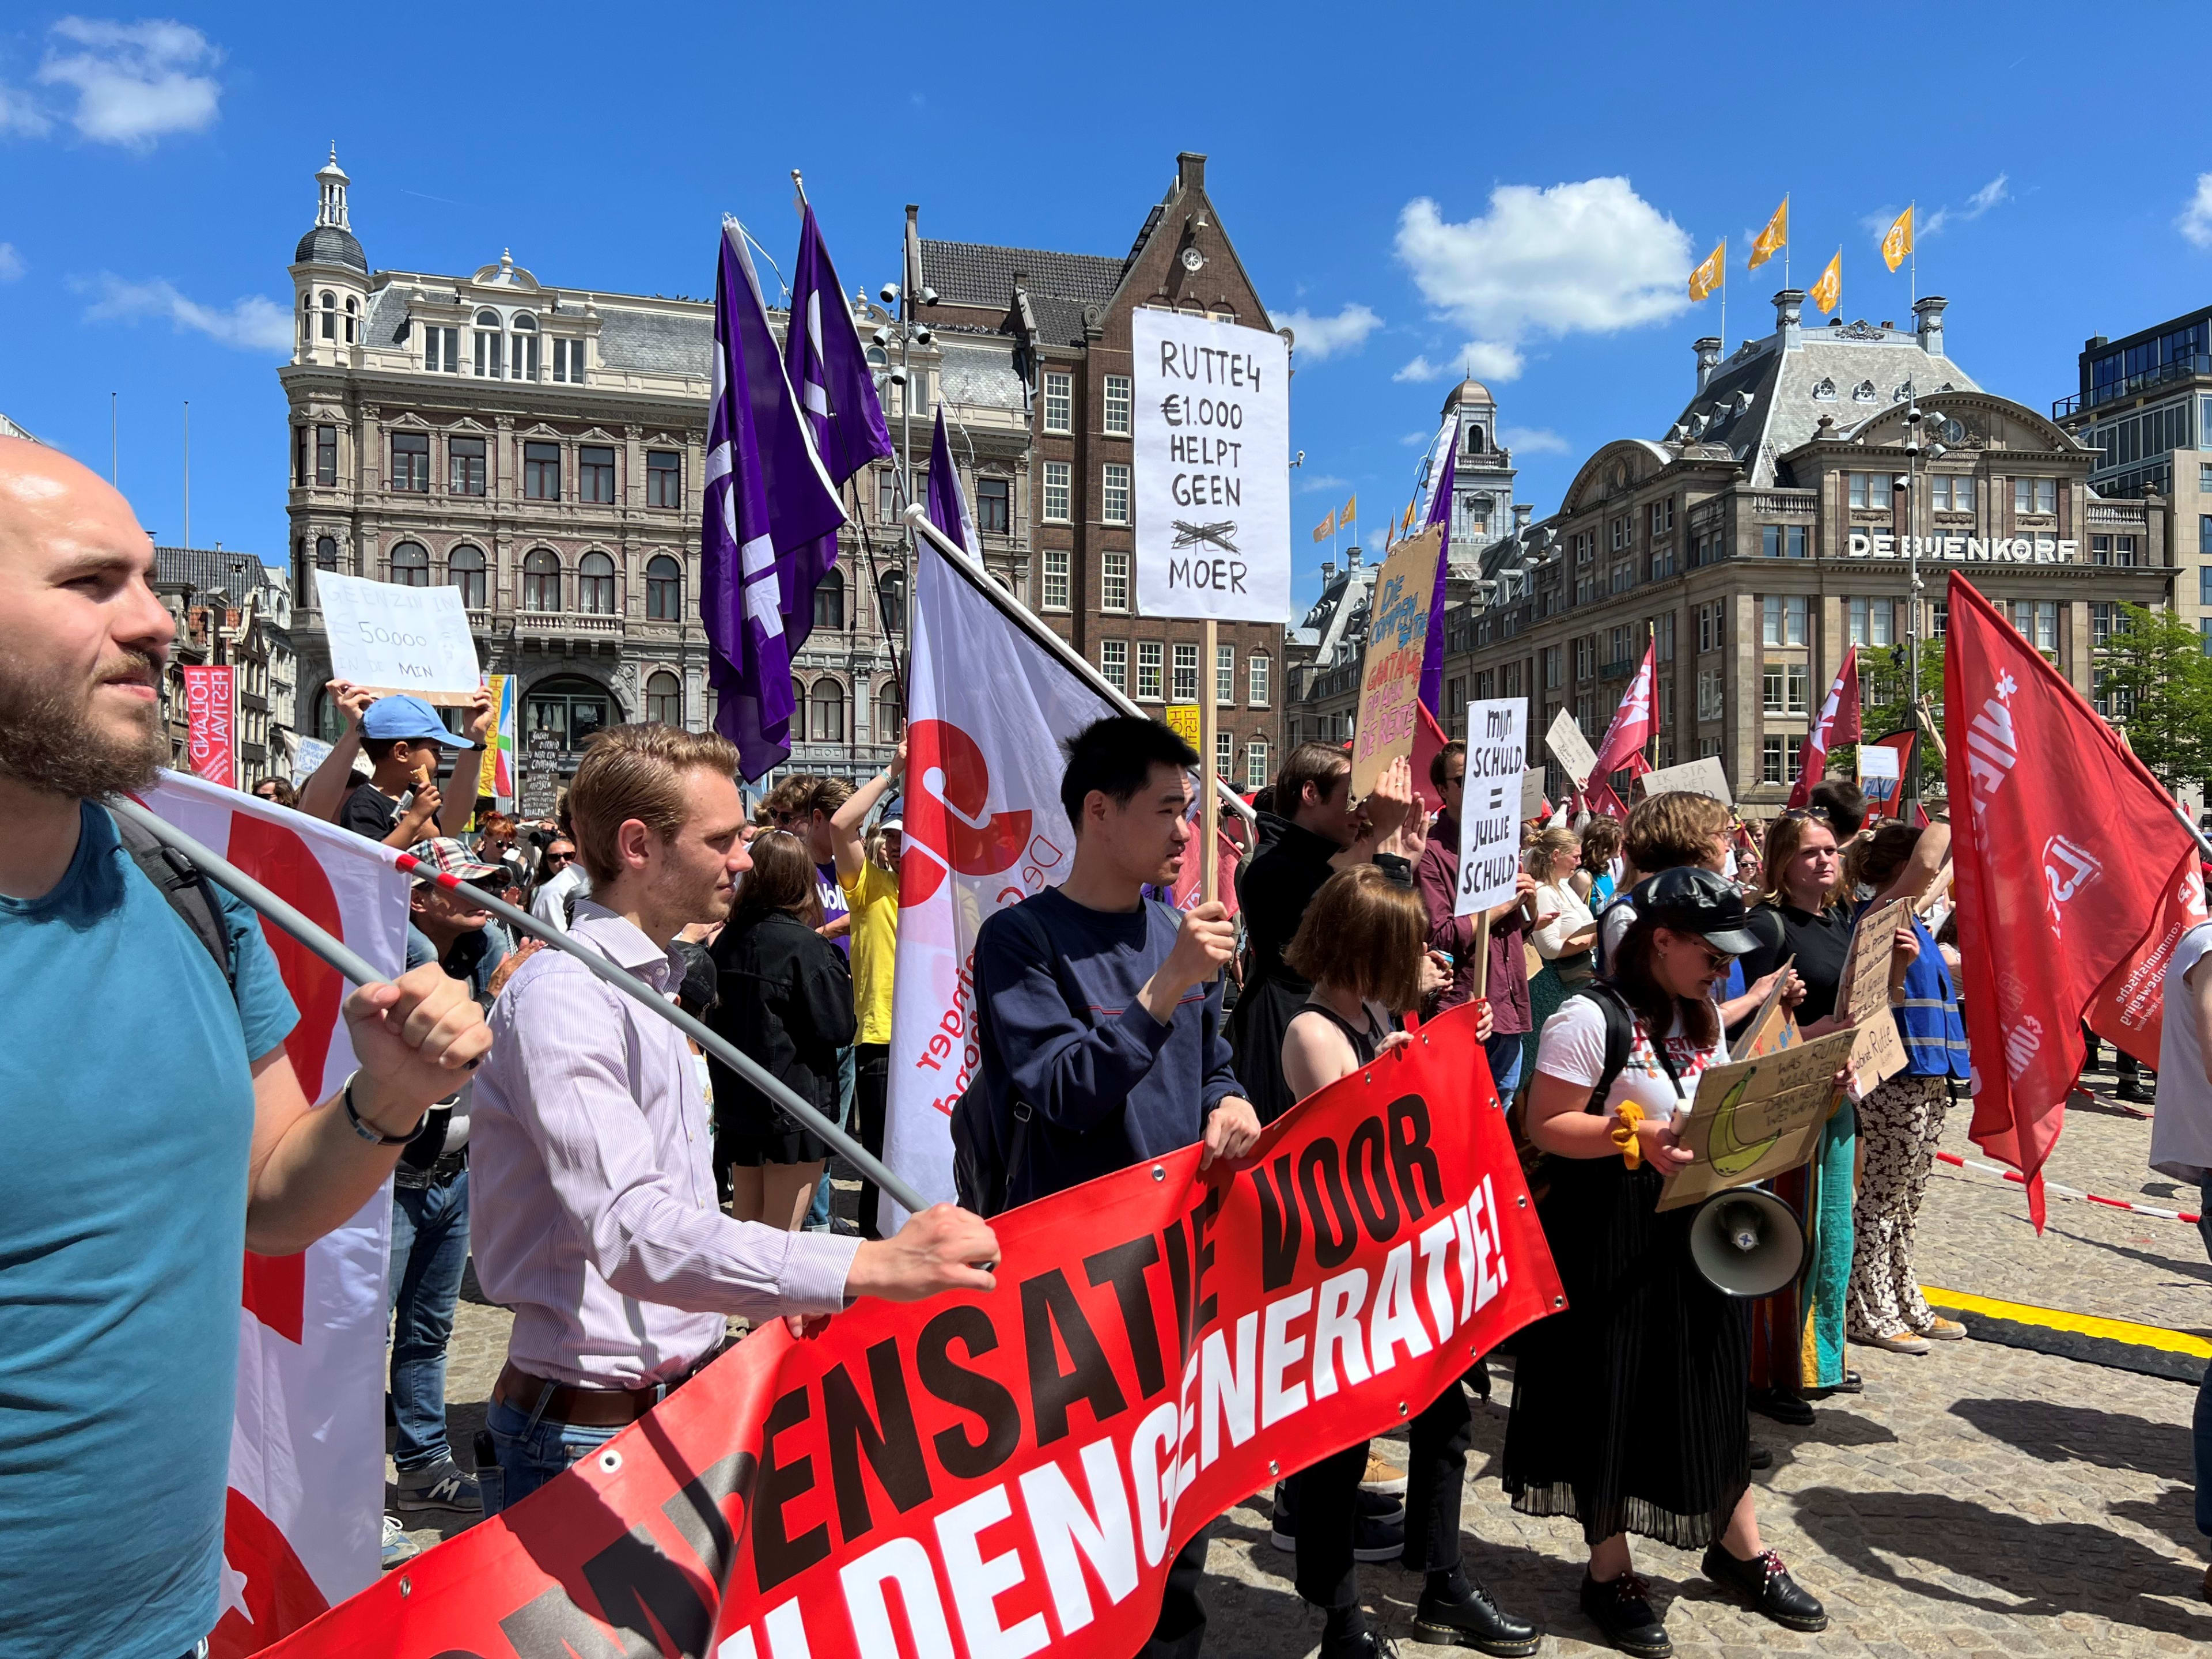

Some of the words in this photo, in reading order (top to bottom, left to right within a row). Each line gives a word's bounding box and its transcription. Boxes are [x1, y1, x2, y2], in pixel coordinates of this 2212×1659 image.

[1160, 394, 1243, 430] €1.000
[1171, 434, 1242, 468] HELPT
[1172, 474, 1241, 506] GEEN
[1849, 533, 1895, 558] DE
[1901, 535, 2080, 564] BIJENKORF
[1169, 558, 1248, 595] MOER
[1380, 575, 1406, 615] DIE
[399, 662, 434, 678] MIN
[1358, 720, 1377, 764] DE
[1376, 698, 1418, 753] RENTE
[1473, 745, 1522, 778] SCHULD
[1654, 772, 1672, 786] IK
[1681, 764, 1707, 778] STA
[1683, 777, 1706, 790] HET
[1471, 815, 1510, 853] JULLIE
[1461, 854, 1515, 895] SCHULD
[1810, 1035, 1852, 1060] RUTTE
[1869, 1027, 1893, 1058] Rutte
[1251, 1092, 1446, 1289] VOOR
